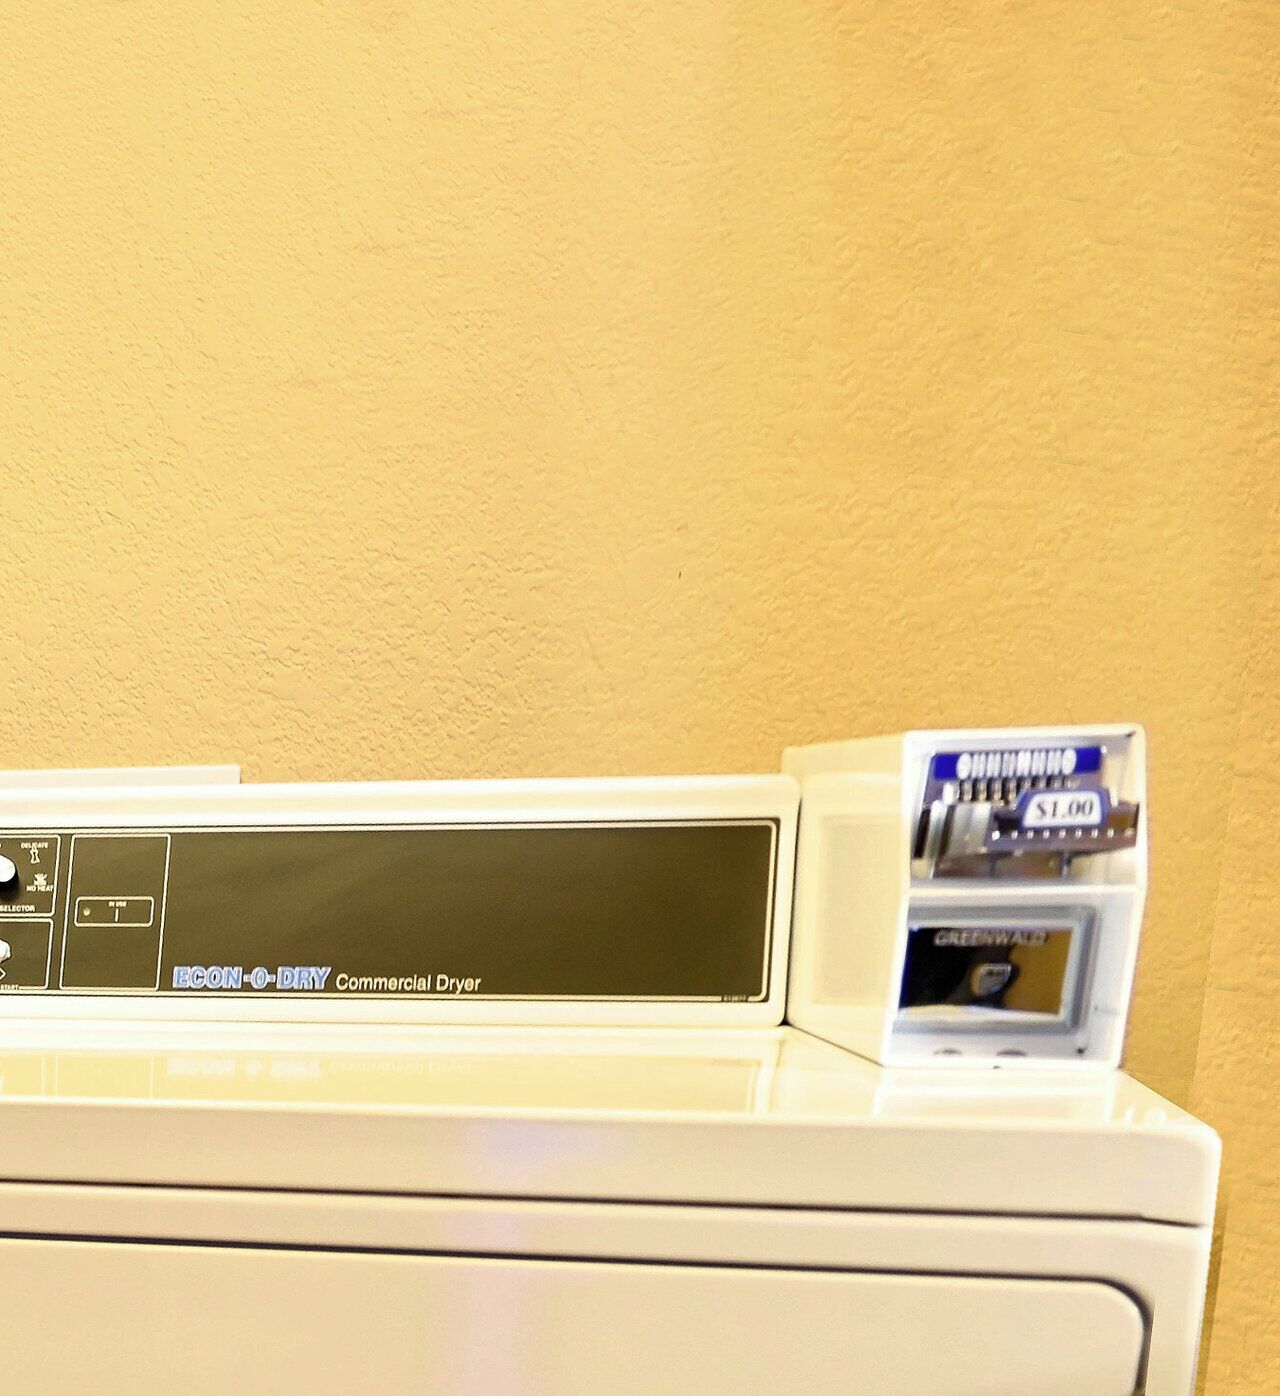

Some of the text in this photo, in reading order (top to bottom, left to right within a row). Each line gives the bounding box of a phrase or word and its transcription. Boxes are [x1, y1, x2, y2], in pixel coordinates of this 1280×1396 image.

[1035, 800, 1095, 818] $1.00
[0, 905, 35, 913] SELECTOR
[173, 966, 482, 995] ECON-O-DRY Commercial Dryer
